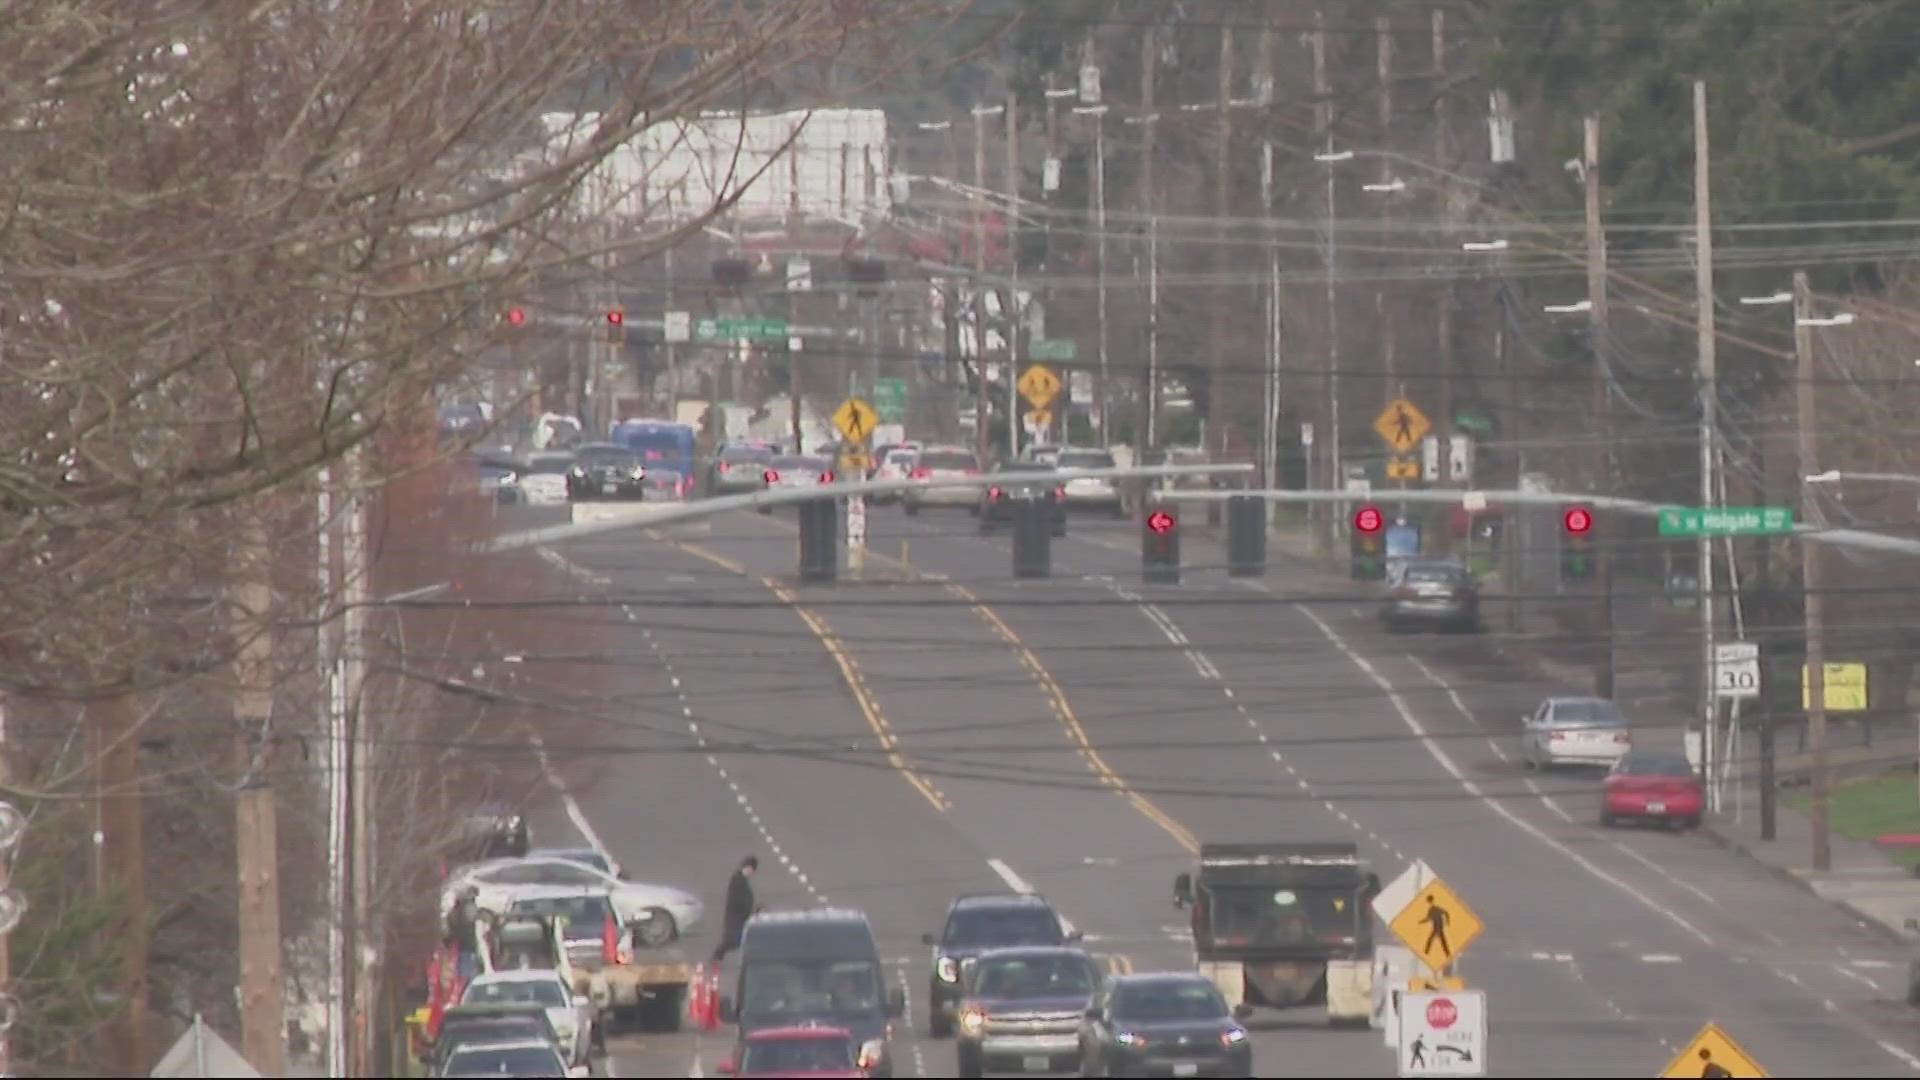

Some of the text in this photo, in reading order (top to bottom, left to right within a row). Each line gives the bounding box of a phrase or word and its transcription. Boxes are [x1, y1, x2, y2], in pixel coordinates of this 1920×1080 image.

[1702, 511, 1761, 532] Holgate
[1720, 671, 1755, 690] 30
[1427, 1004, 1456, 1021] STOP
